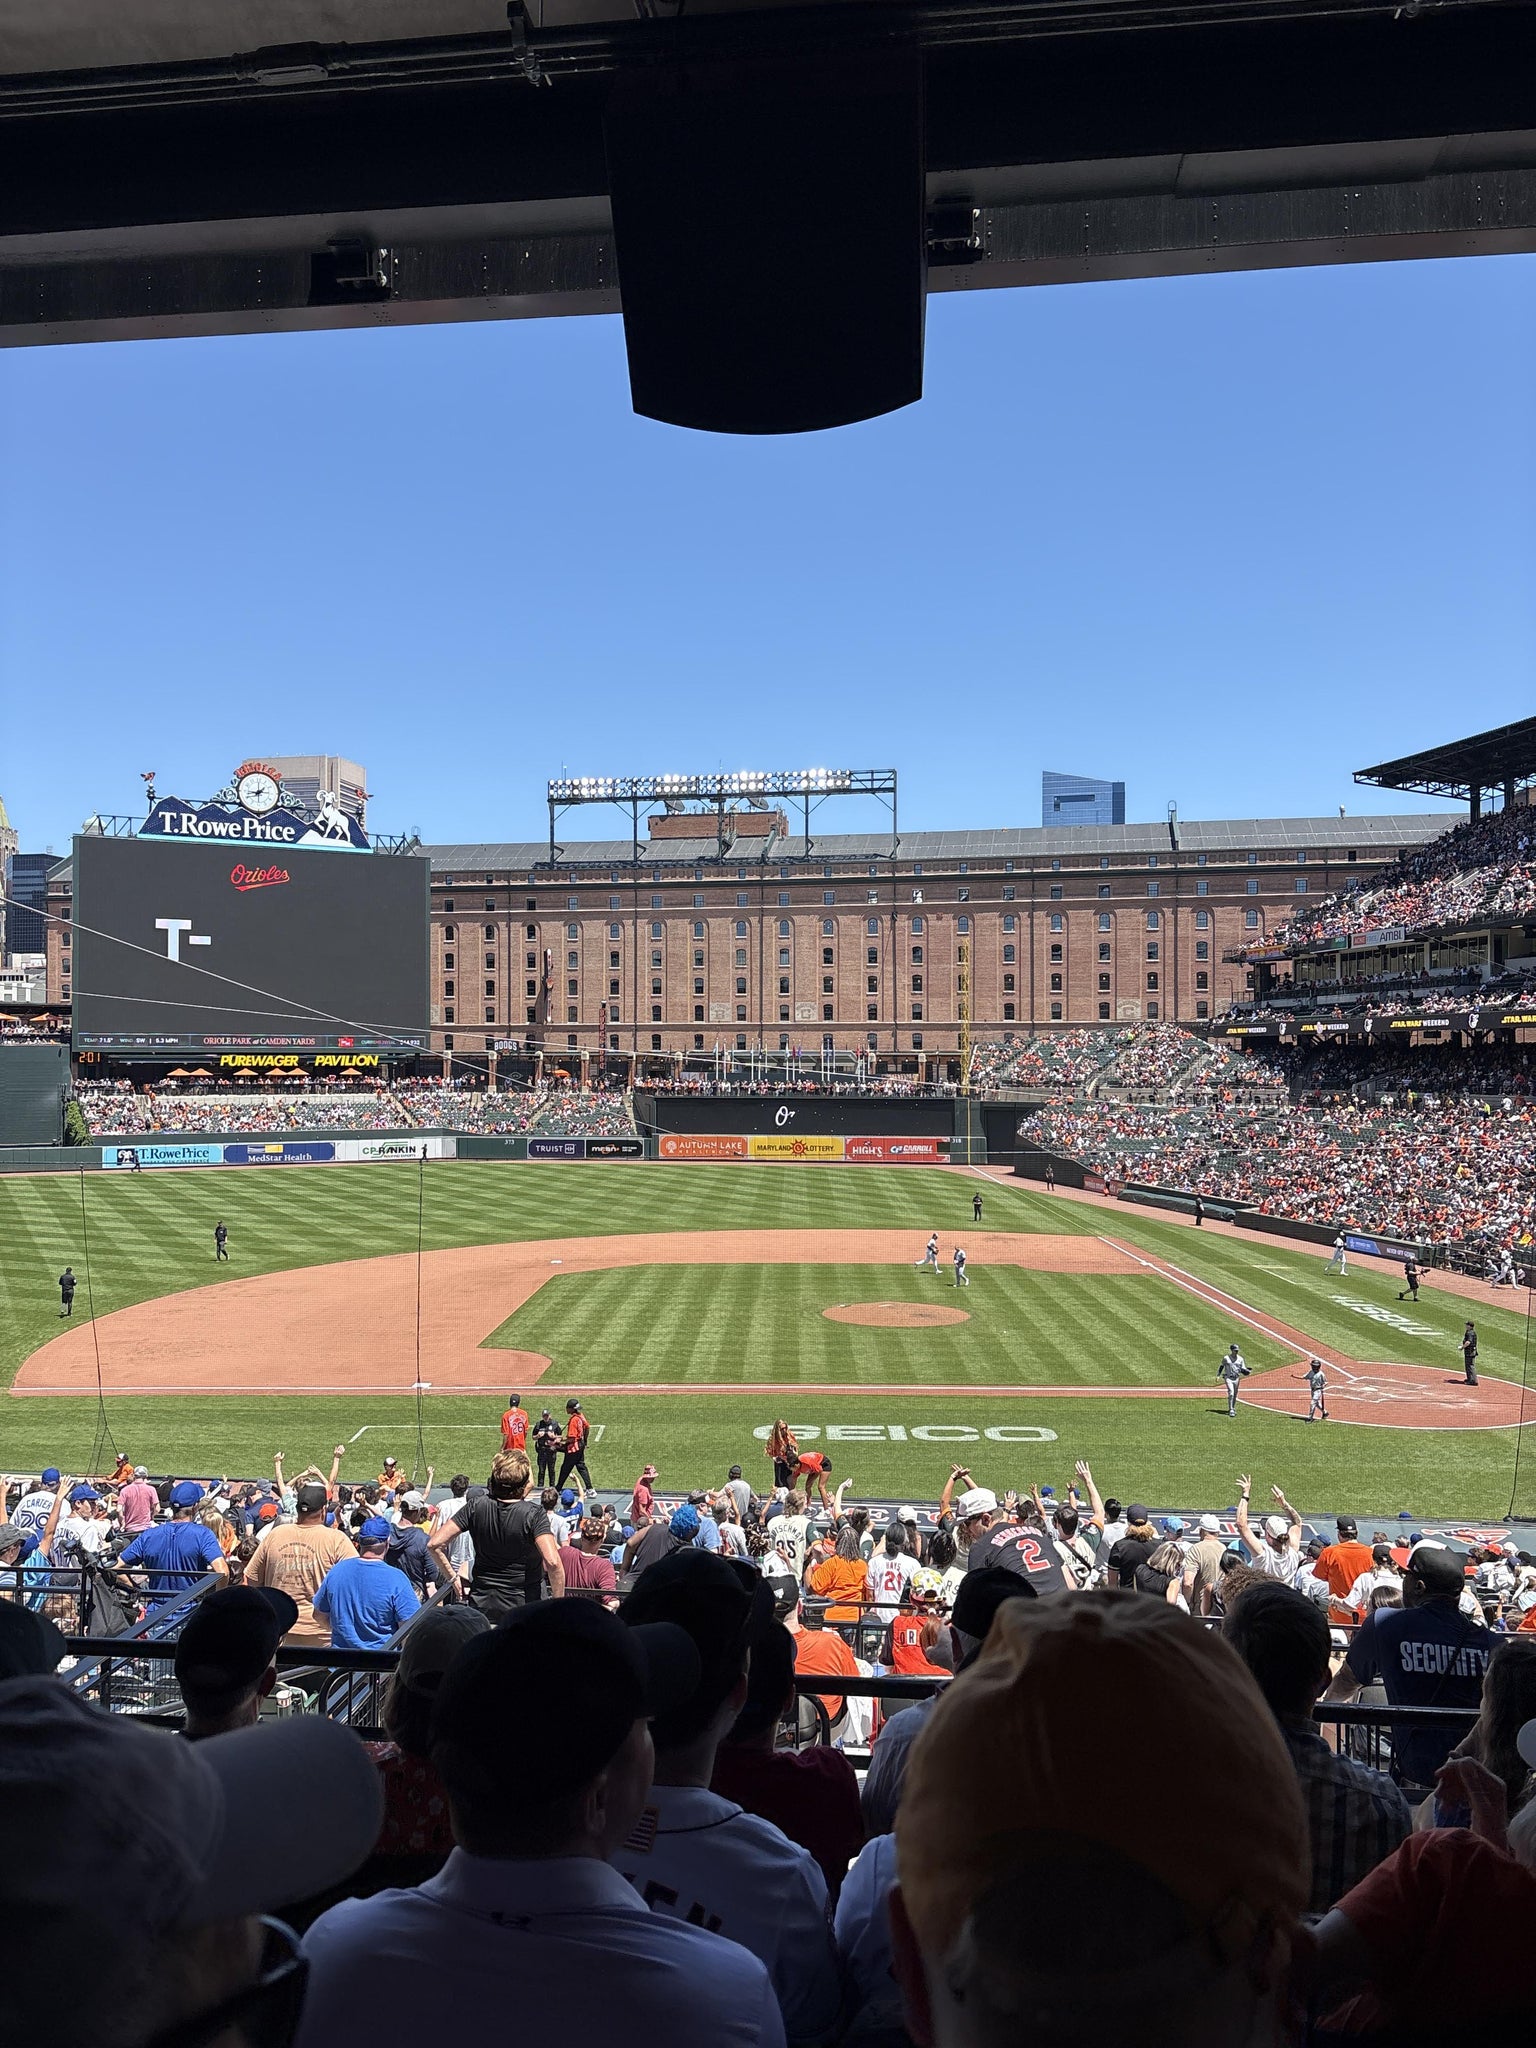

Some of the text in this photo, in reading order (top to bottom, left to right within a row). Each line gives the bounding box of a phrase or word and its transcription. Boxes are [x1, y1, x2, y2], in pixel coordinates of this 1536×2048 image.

[242, 817, 296, 842] Price
[230, 863, 290, 891] Orioles
[1422, 1018, 1450, 1027] WEEKEND
[203, 1036, 232, 1045] ORIOLE
[232, 1036, 252, 1045] PARK
[260, 1037, 291, 1046] CAMDEN
[292, 1037, 316, 1046] YARDS
[220, 1054, 379, 1067] PUREWAGER PAVILION
[535, 1144, 563, 1153] TRUIST
[720, 1141, 742, 1149] LAKE
[756, 1144, 834, 1152] MARYLAND LOTTERY
[181, 1147, 210, 1159] Price
[248, 1152, 312, 1162] MedStar Health
[752, 1424, 1059, 1442] GEICO
[26, 1498, 53, 1511] CARTER
[1016, 1538, 1051, 1573] 2
[1399, 1640, 1489, 1677] SECURITY
